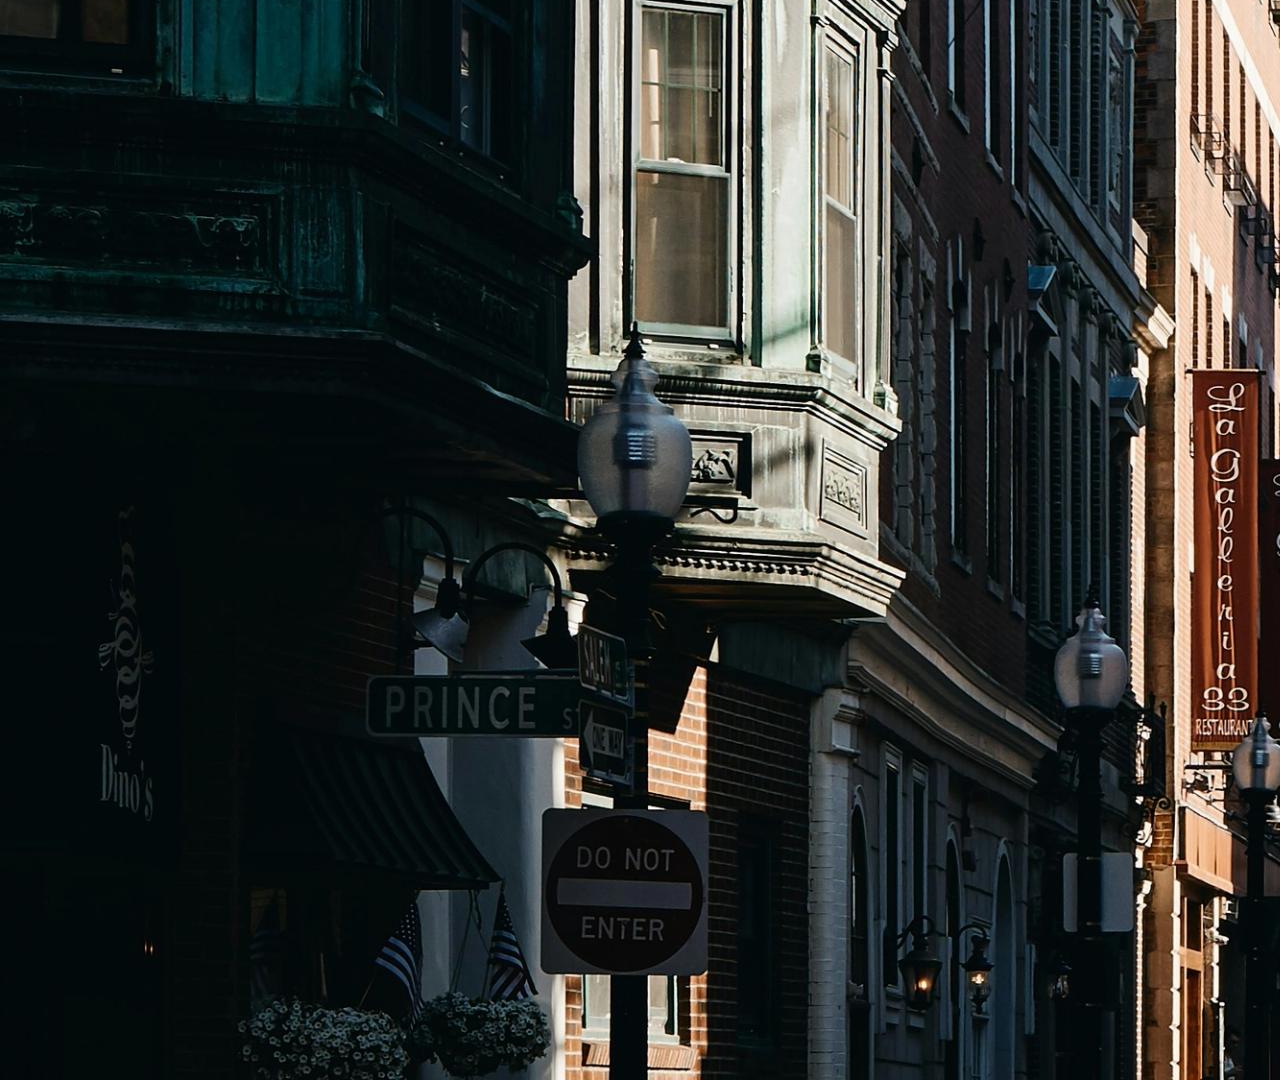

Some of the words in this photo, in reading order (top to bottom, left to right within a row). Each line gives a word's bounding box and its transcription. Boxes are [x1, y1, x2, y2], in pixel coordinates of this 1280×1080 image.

[1207, 383, 1246, 436] La
[1210, 448, 1241, 680] Galleria
[385, 686, 536, 730] PRINCE
[562, 708, 580, 729] S
[1201, 687, 1250, 711] 33
[1196, 720, 1253, 736] RESTAURANT
[99, 743, 153, 822] Dino's
[577, 846, 611, 869] DO
[625, 848, 675, 871] NOT
[581, 916, 664, 941] ENTER
